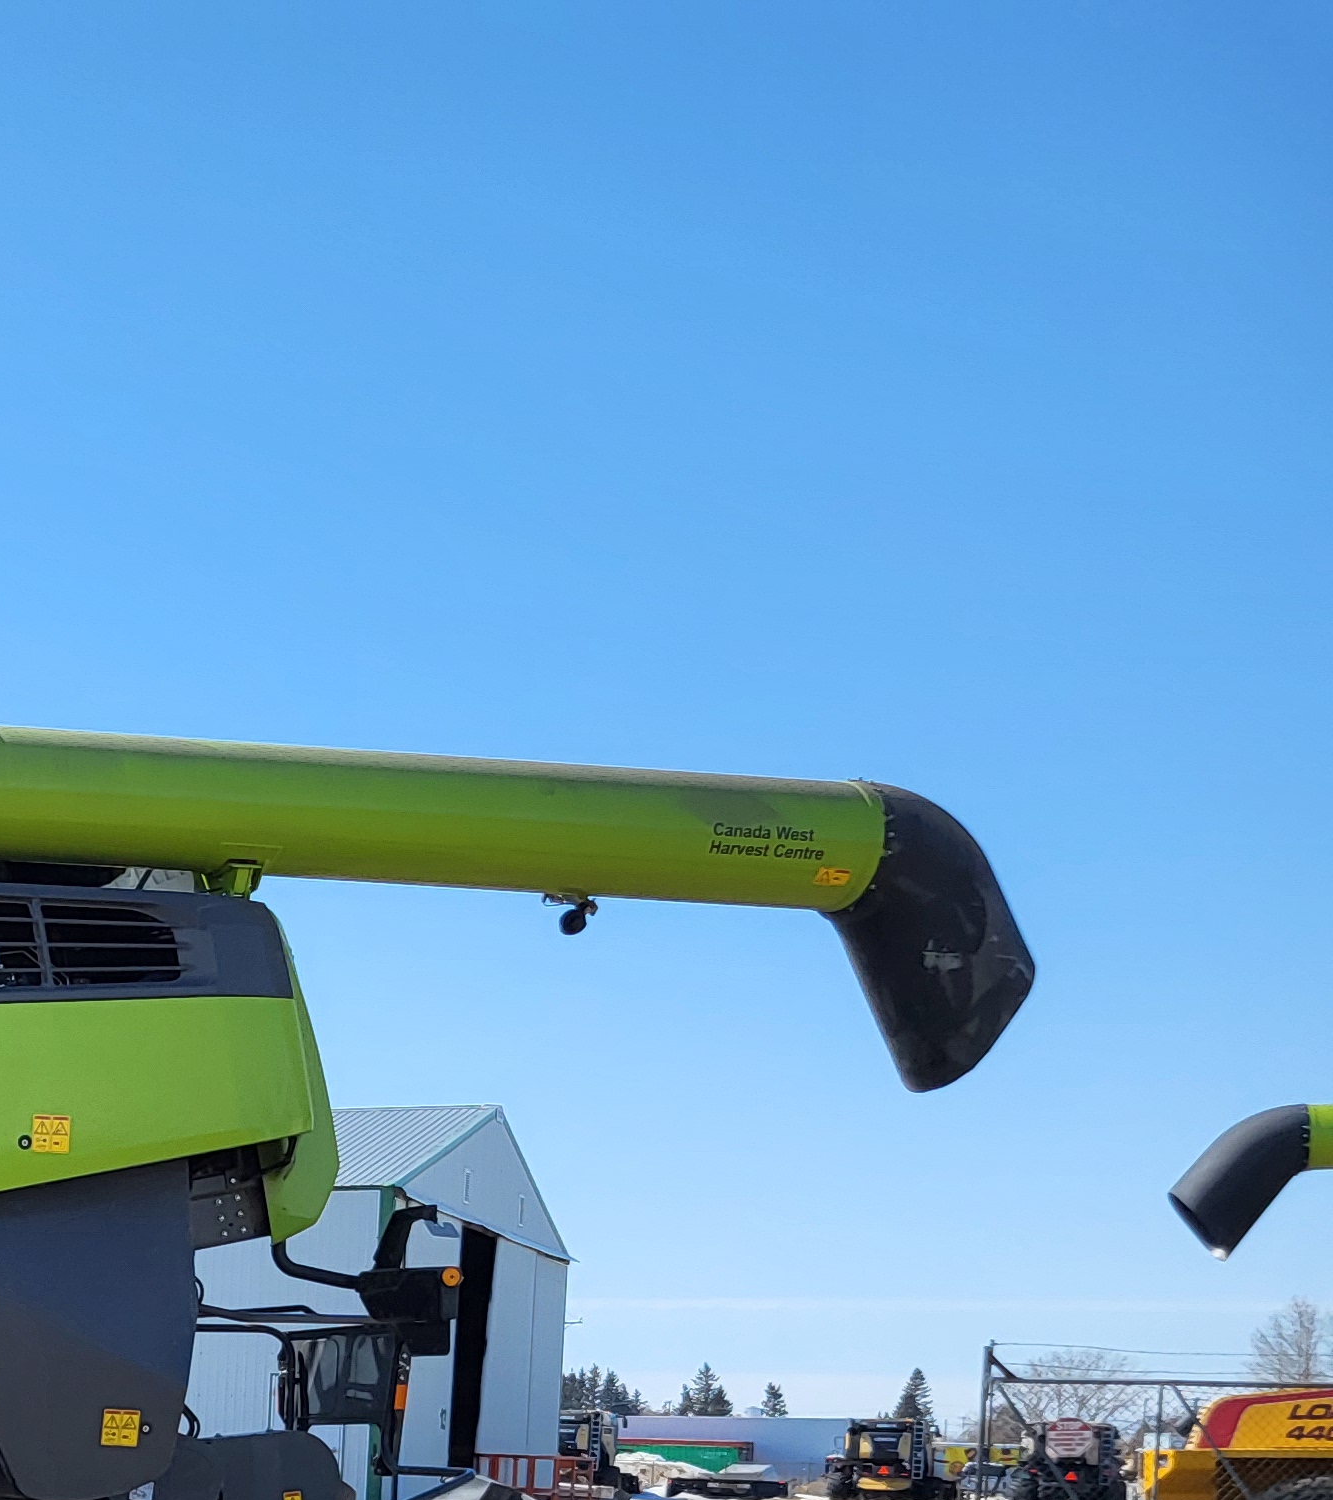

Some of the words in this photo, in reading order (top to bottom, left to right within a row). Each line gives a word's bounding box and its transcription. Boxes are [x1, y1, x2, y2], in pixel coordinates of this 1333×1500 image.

[713, 823, 771, 839] Canada
[776, 826, 815, 841] West
[709, 840, 769, 857] Harvest
[774, 844, 824, 860] Centre
[1287, 1403, 1333, 1420] LO
